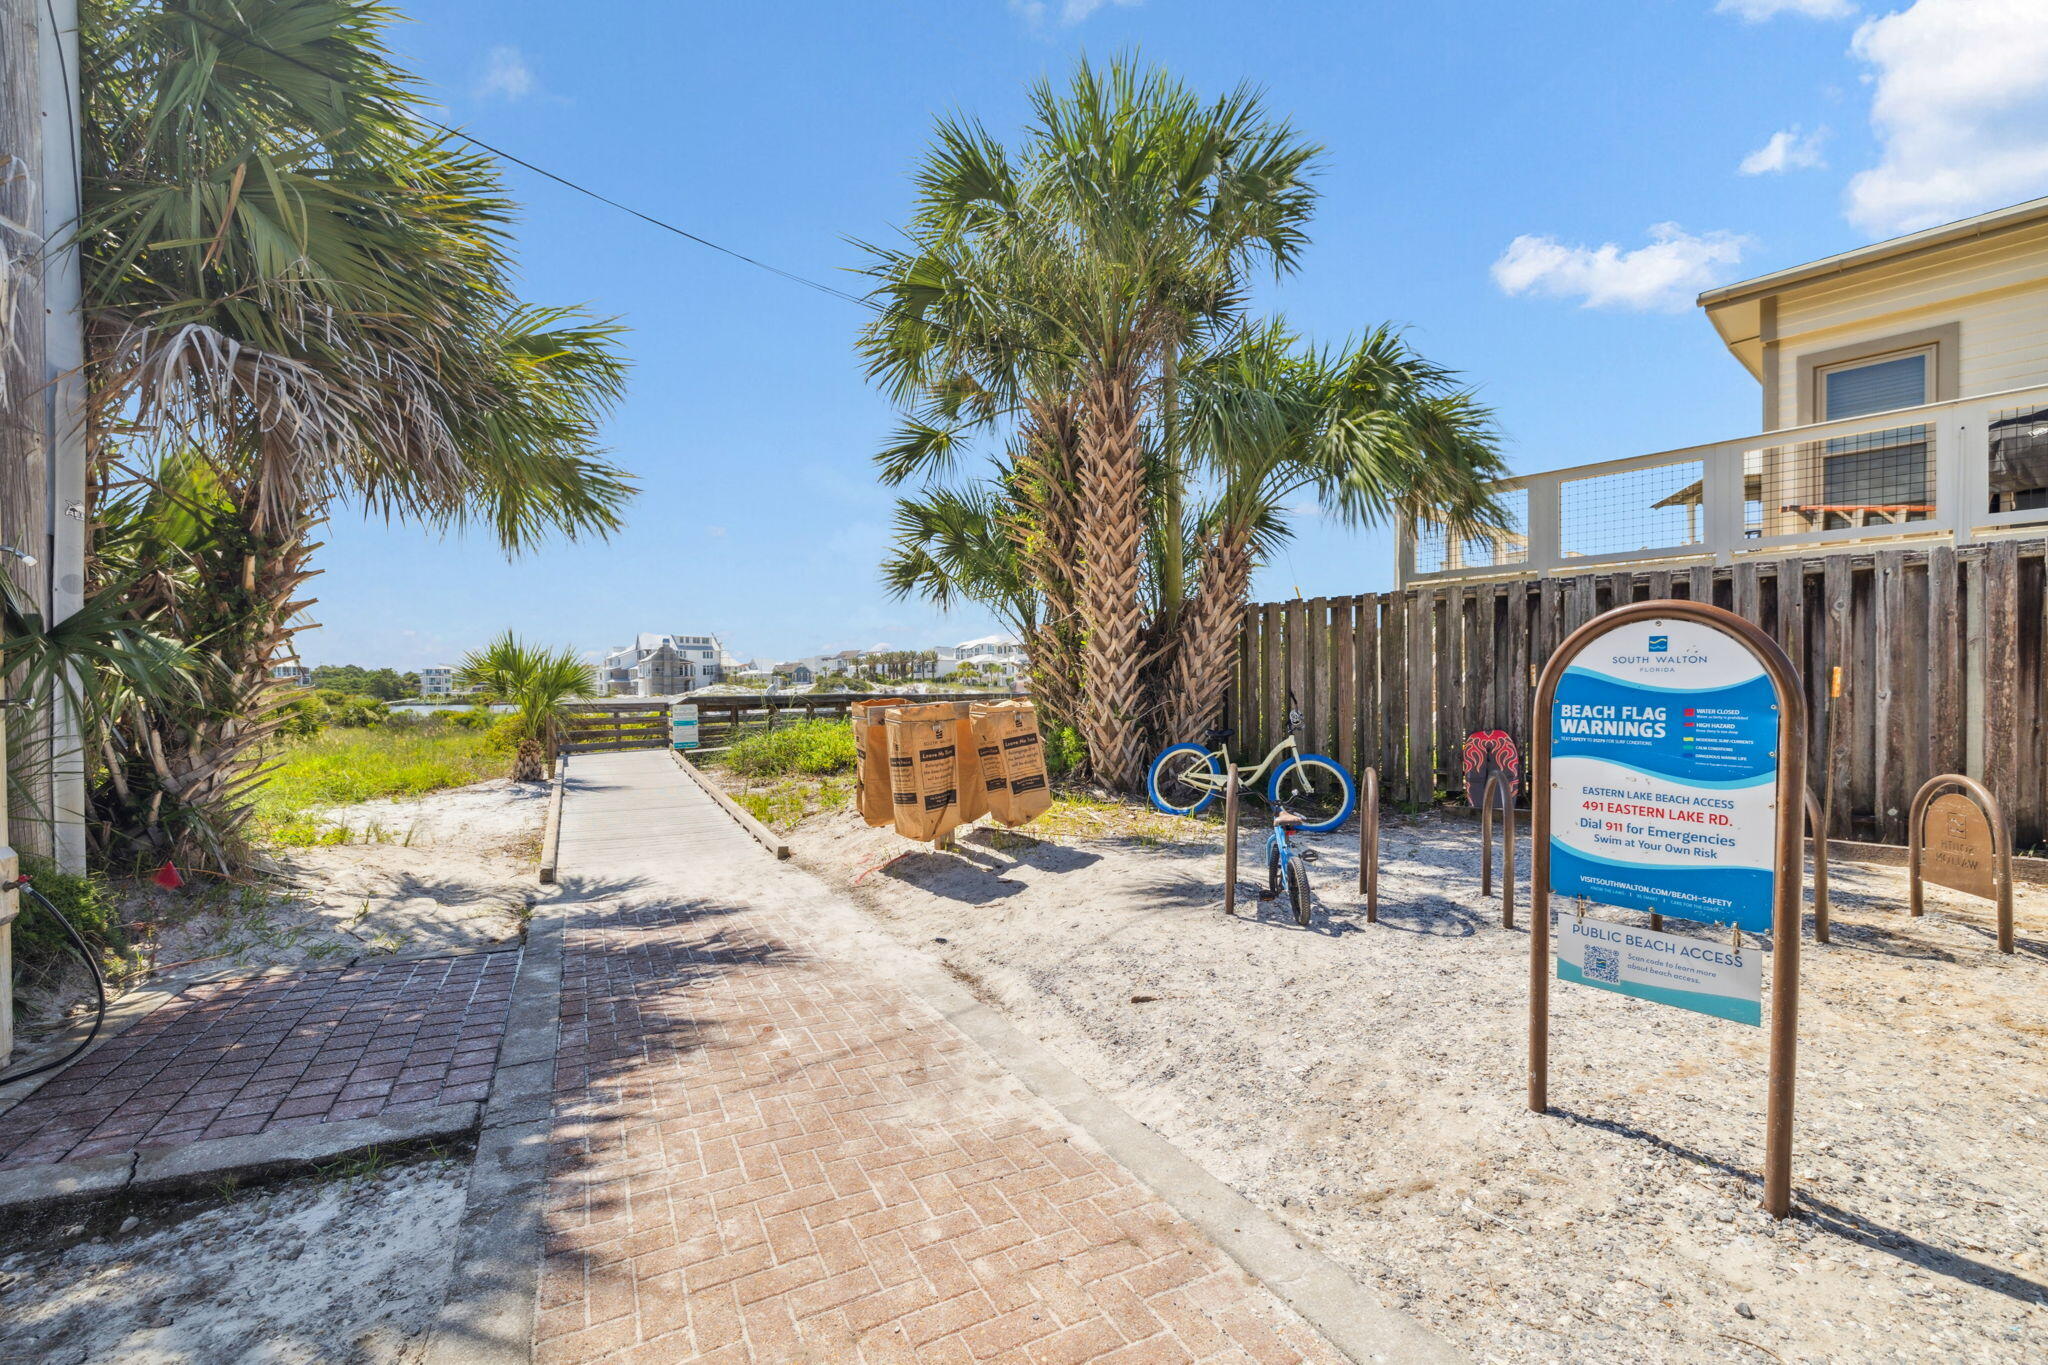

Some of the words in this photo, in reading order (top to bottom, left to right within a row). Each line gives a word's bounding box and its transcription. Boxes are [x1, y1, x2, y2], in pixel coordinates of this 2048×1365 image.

[1612, 656, 1649, 664] SOUTH
[1656, 655, 1708, 664] WALTON
[1561, 704, 1615, 719] BEACH
[1622, 706, 1667, 721] FLAG
[1560, 719, 1666, 738] WARNINGS
[1582, 786, 1625, 798] EASTERN
[1627, 791, 1652, 801] LAKE
[1655, 793, 1690, 804] BEACH
[1692, 797, 1734, 809] ACCESS
[1582, 800, 1604, 812] 491
[1607, 802, 1665, 818] EASTERN
[1669, 809, 1704, 823] LAKE
[1708, 813, 1733, 827] RD.
[1580, 817, 1602, 829] Dial
[1605, 821, 1623, 832] 911
[1626, 822, 1644, 834] for
[1647, 826, 1736, 847] Emergencies
[1594, 833, 1622, 845] Swim
[1625, 839, 1635, 847] at
[1638, 840, 1661, 851] Your
[1665, 843, 1691, 856] Own
[1693, 847, 1718, 859] Risk
[1580, 875, 1733, 907] VISITSOUTHWALTON.COM/BEACH-SAFETY
[1572, 923, 1621, 943] PUBLIC
[1625, 934, 1675, 954] BEACH
[1680, 946, 1743, 967] ACCESS
[1627, 953, 1645, 963] Scan
[1646, 957, 1664, 967] code
[1665, 961, 1673, 969] to
[1674, 963, 1695, 974] learn
[1696, 969, 1717, 978] more
[1627, 963, 1648, 973] about
[1649, 967, 1673, 978] beach
[1674, 974, 1701, 984] access.
